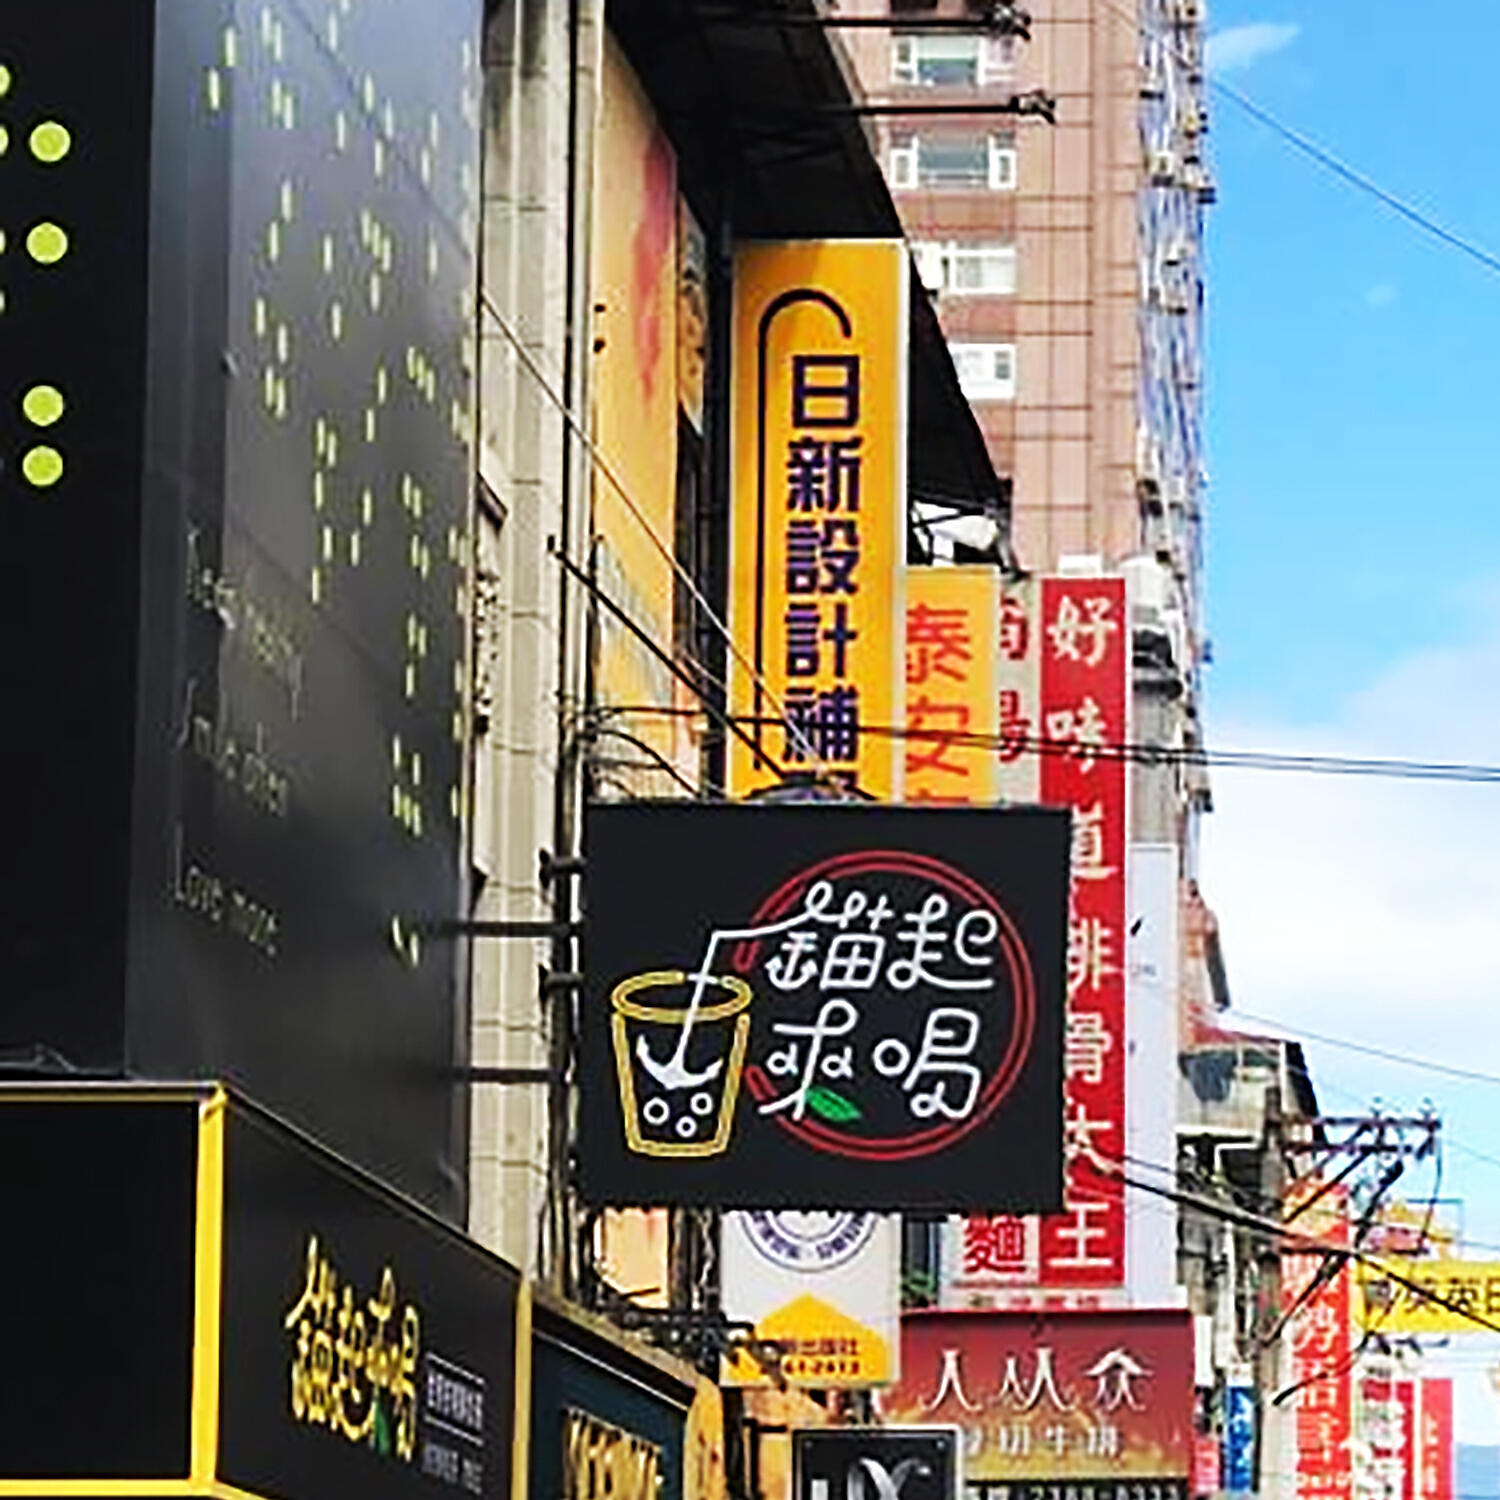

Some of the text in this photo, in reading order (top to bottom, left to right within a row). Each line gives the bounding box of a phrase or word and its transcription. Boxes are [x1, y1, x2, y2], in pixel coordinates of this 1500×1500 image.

[783, 353, 864, 800] 日新設計補
[904, 603, 976, 803] 泰安
